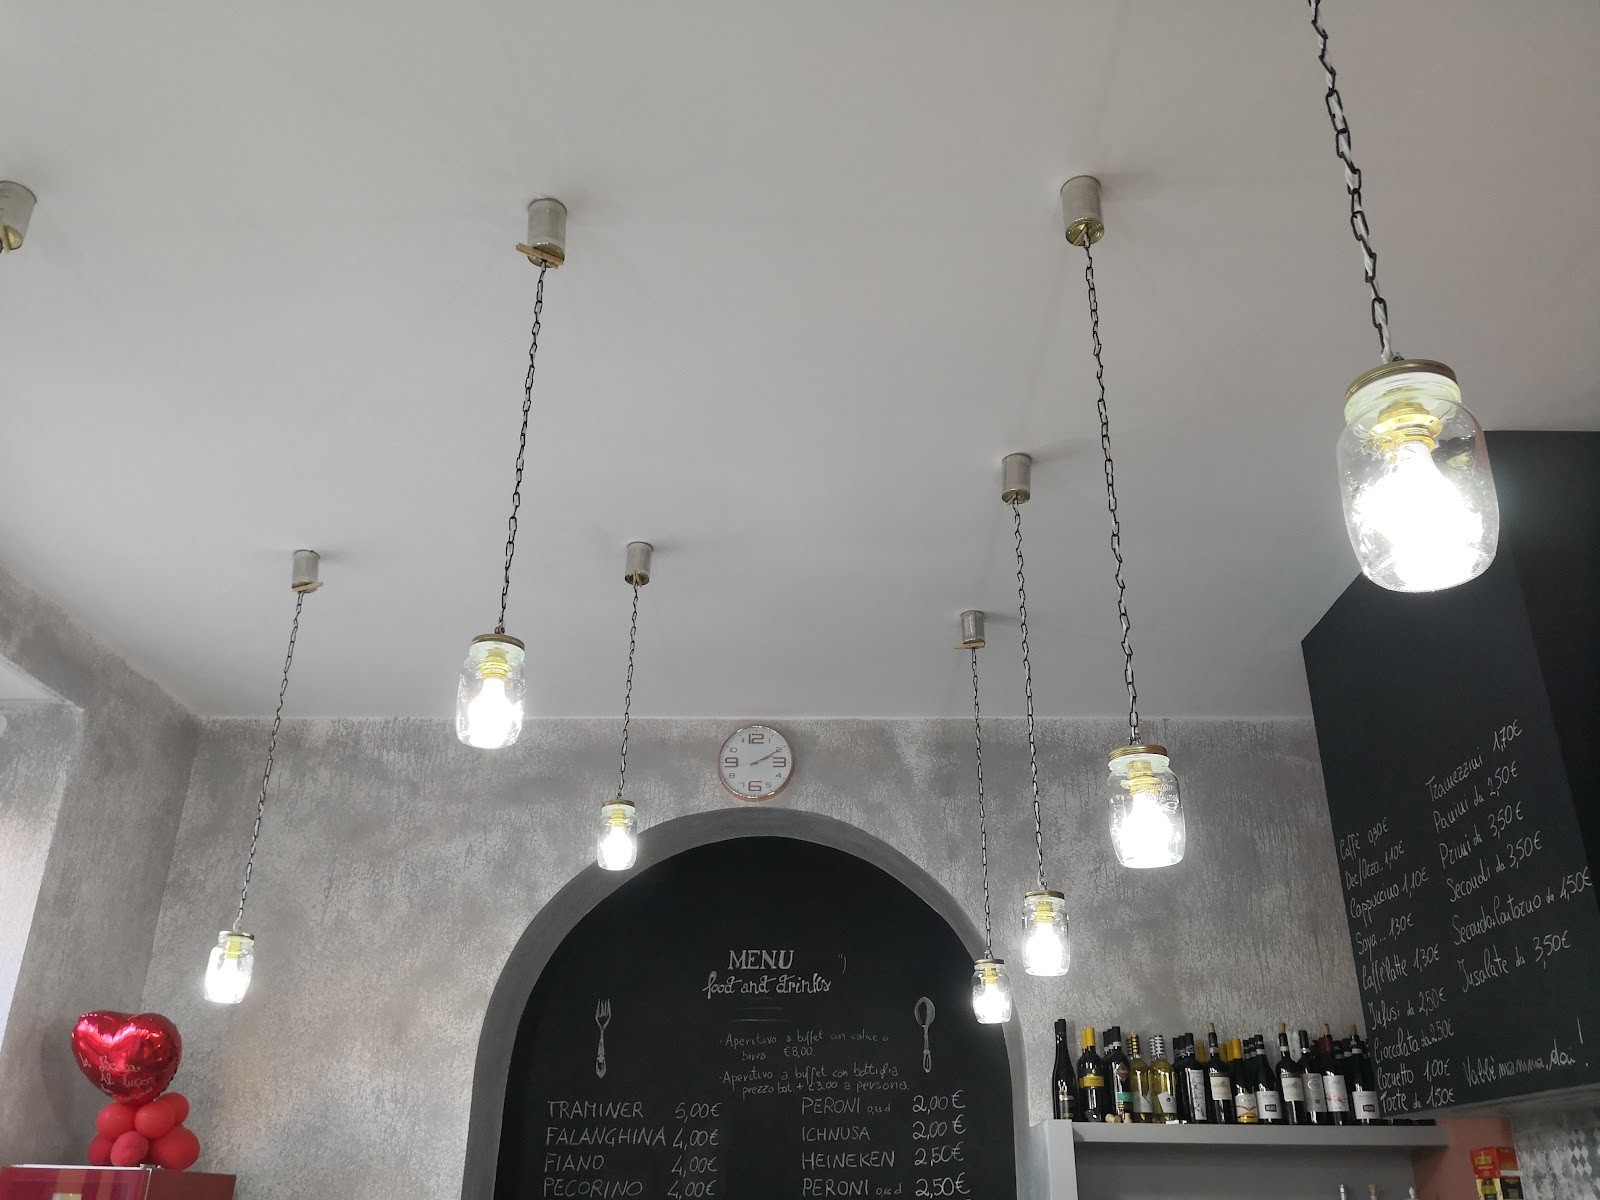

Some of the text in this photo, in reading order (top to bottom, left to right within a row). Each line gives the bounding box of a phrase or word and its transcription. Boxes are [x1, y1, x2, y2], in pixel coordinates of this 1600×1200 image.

[748, 733, 764, 745] 12
[724, 757, 739, 768] 9
[772, 757, 787, 768] 3
[1425, 719, 1523, 802] Tramezzini 1,70€
[748, 780, 762, 792] 6
[1433, 760, 1518, 833] Panini da 2,50€
[1367, 816, 1389, 846] 0,90€
[1439, 801, 1523, 869] Primi da 3,50€
[1384, 840, 1405, 870] 1,10€
[1446, 830, 1543, 903] Secondi da 3,50€
[1350, 866, 1429, 928] Cappuccino 1,10€
[1546, 886, 1555, 904] da
[1560, 866, 1593, 900] 4,50€
[1388, 912, 1414, 941] 1,30€
[727, 949, 795, 970] MENU
[1413, 943, 1440, 973] 1,30€
[1456, 929, 1572, 993] Insalate da 3,50€
[702, 970, 832, 1000] food and drinks
[1407, 999, 1415, 1016] da
[1418, 986, 1446, 1016] 2,50€
[725, 1033, 777, 1050] Aperitivo
[786, 1035, 792, 1043] a
[796, 1029, 824, 1046] buffet
[830, 1031, 846, 1041] con
[850, 1028, 878, 1042] calice
[1374, 1027, 1420, 1064] Cioccolata
[741, 1046, 814, 1061] birra €8,00
[722, 1066, 773, 1091] Aperitivo
[781, 1071, 789, 1081] a
[794, 1065, 827, 1085] buffet
[832, 1068, 849, 1079] con
[1377, 1058, 1451, 1090] Cornetto 1,00€
[742, 1085, 775, 1101] prezzo
[777, 1082, 793, 1094] bot
[843, 1081, 851, 1091] a
[1380, 1088, 1409, 1113] Torte
[1426, 1085, 1456, 1108] 1,50€
[547, 1100, 722, 1123] TRAMINER 5,00€
[801, 1096, 861, 1115] PERONI
[546, 1126, 719, 1150] FALANGHINA 4,00€
[801, 1126, 871, 1142] ICHNUSA
[544, 1152, 718, 1177] FIANO 4,00€
[801, 1141, 964, 1170] HEINEKEN 2,50€
[543, 1177, 717, 1200] PECORINO 4,00€
[802, 1177, 869, 1197] PERONI
[915, 1171, 971, 1199] 2,50€
